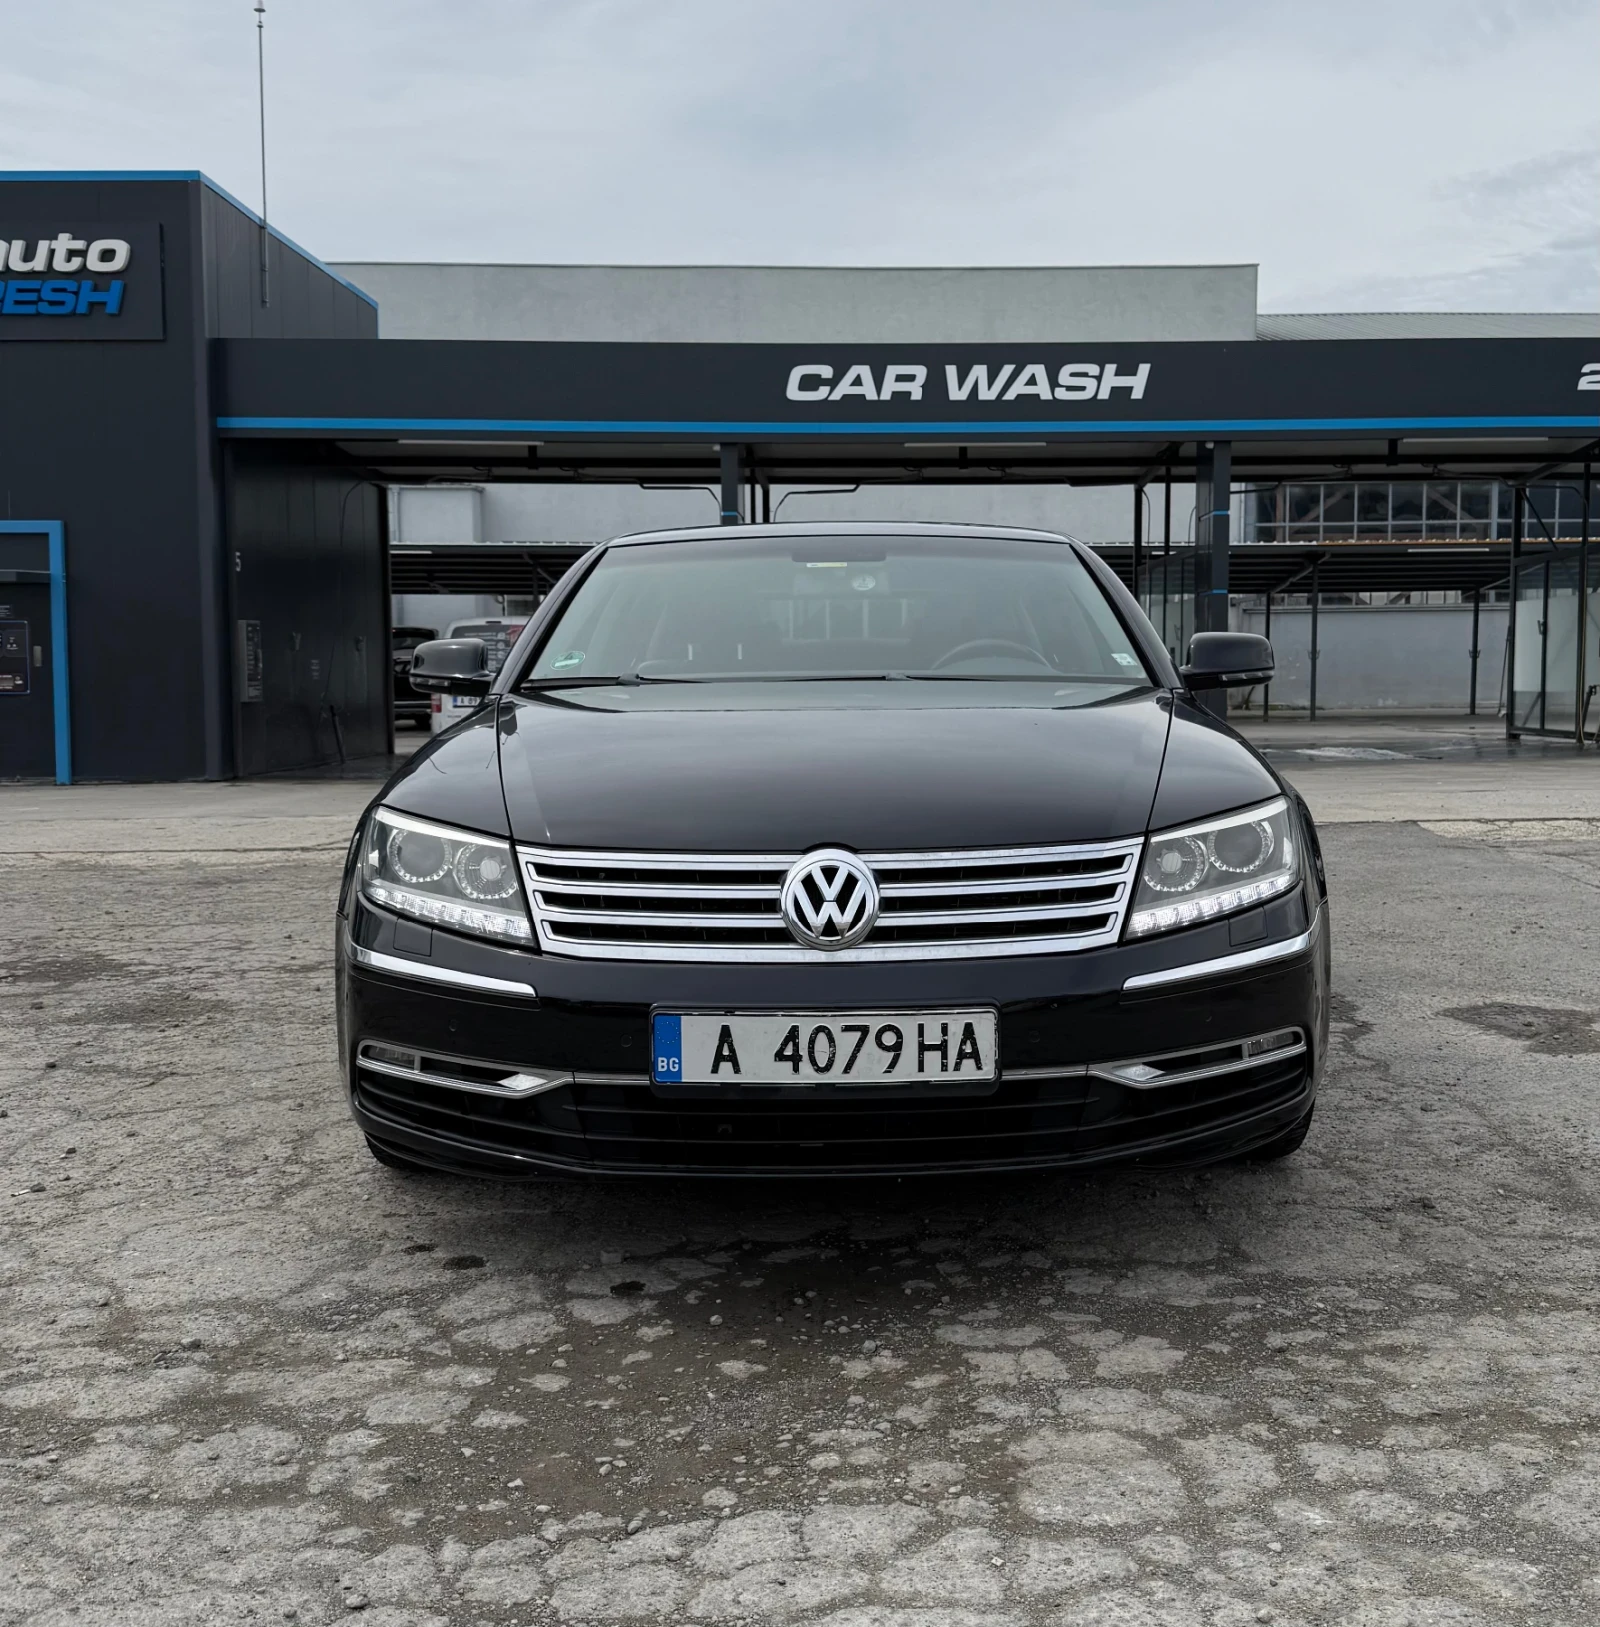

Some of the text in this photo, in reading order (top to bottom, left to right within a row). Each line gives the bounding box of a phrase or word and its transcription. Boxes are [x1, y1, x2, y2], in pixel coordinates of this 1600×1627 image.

[0, 232, 131, 272] uto
[0, 279, 124, 314] ESH
[785, 363, 1151, 400] CAR WASH
[234, 551, 242, 572] 5
[788, 859, 872, 942] VW
[657, 1057, 679, 1072] BG
[710, 1024, 742, 1074] A
